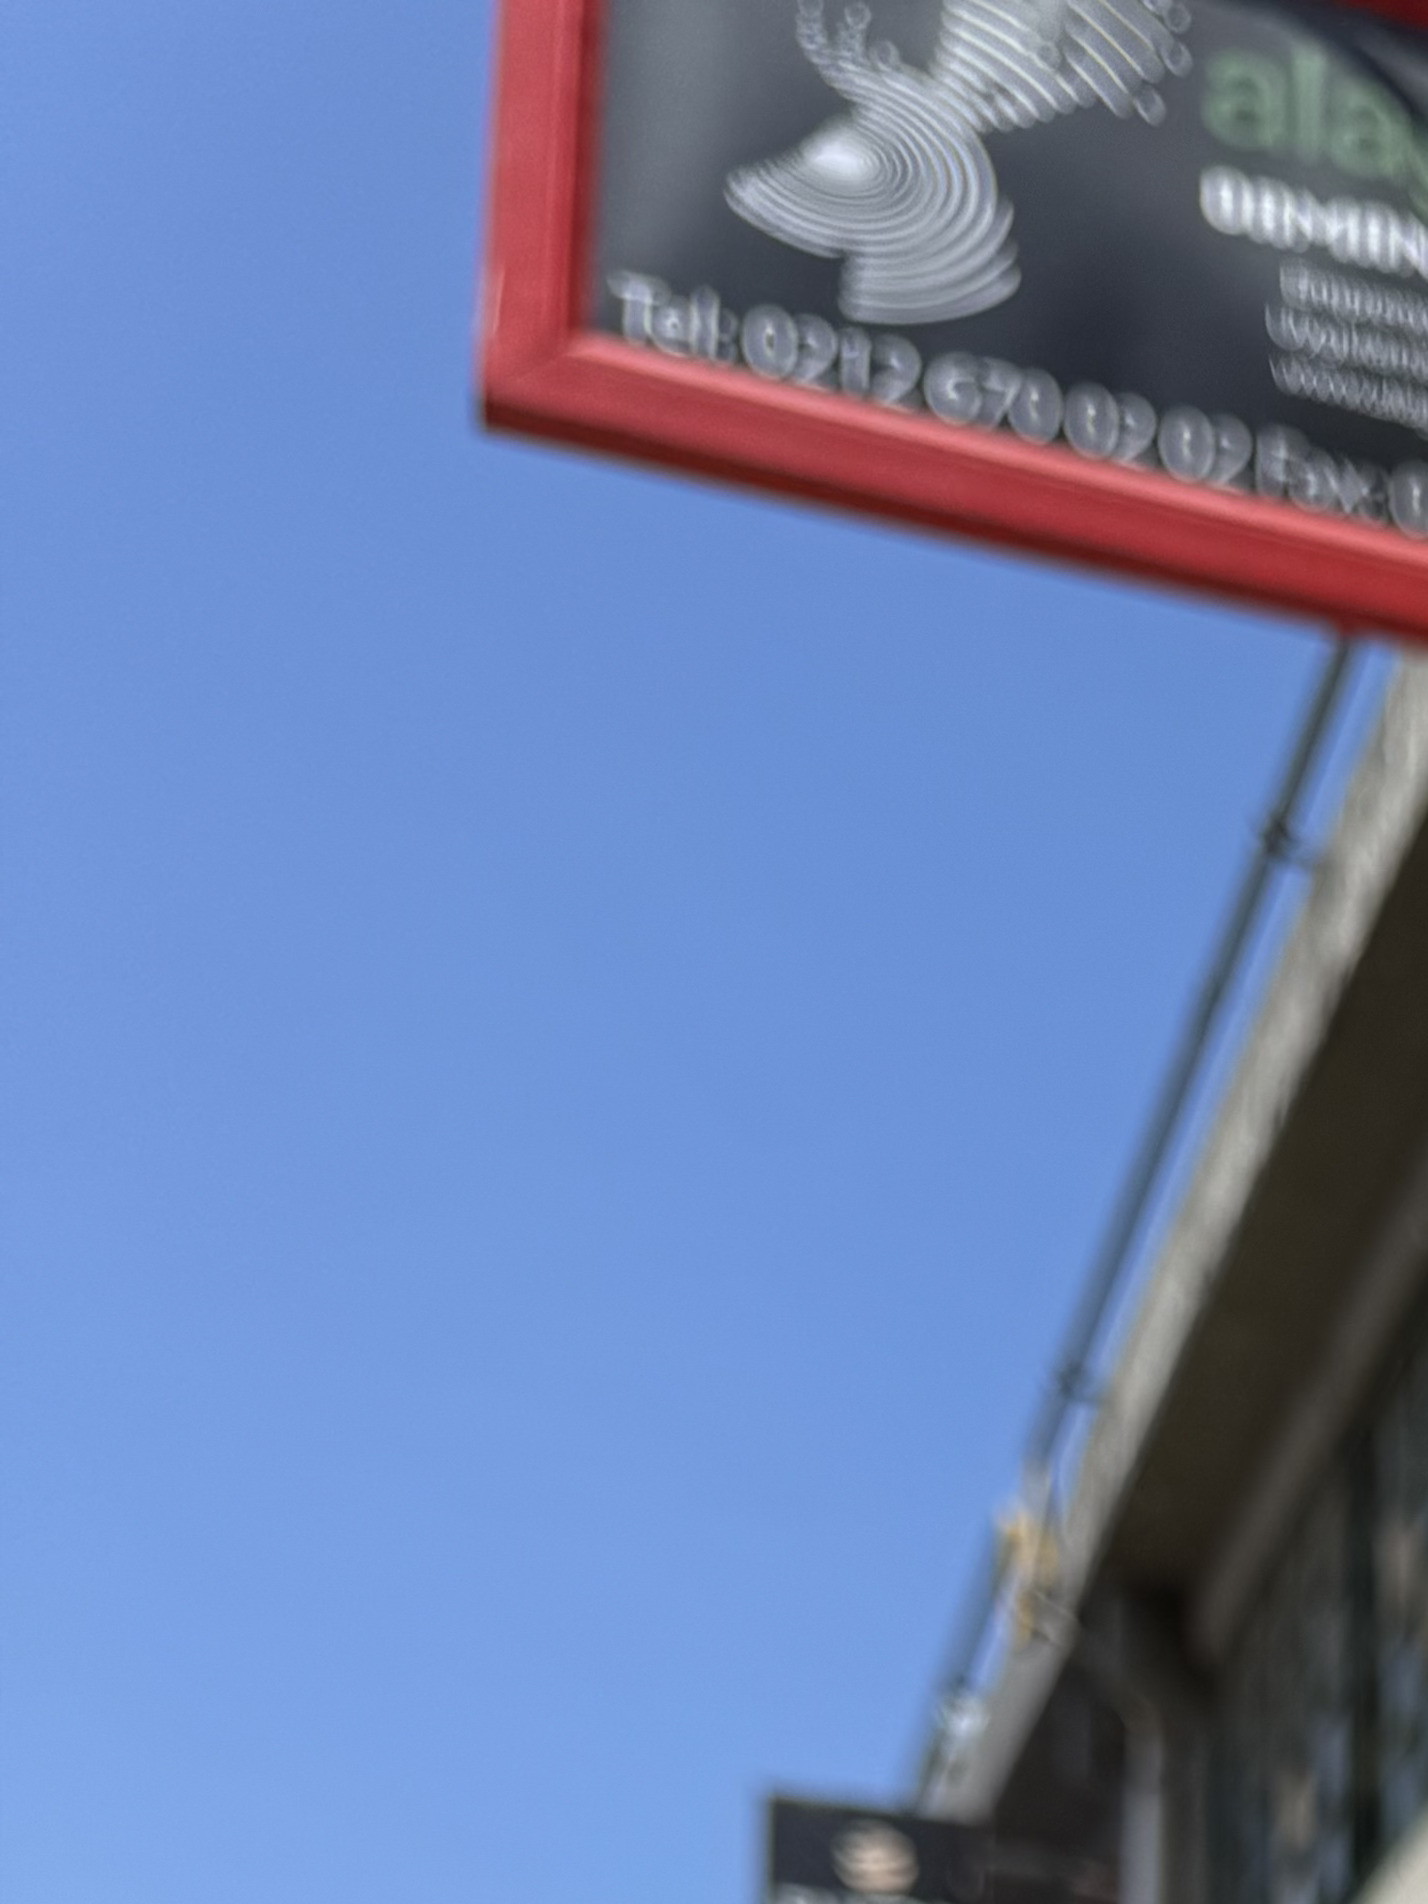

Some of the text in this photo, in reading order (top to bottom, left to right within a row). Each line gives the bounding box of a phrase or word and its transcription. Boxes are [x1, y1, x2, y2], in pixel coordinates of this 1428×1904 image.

[741, 303, 921, 414] 0212
[1064, 380, 1158, 472] 02
[1157, 405, 1253, 490] 02
